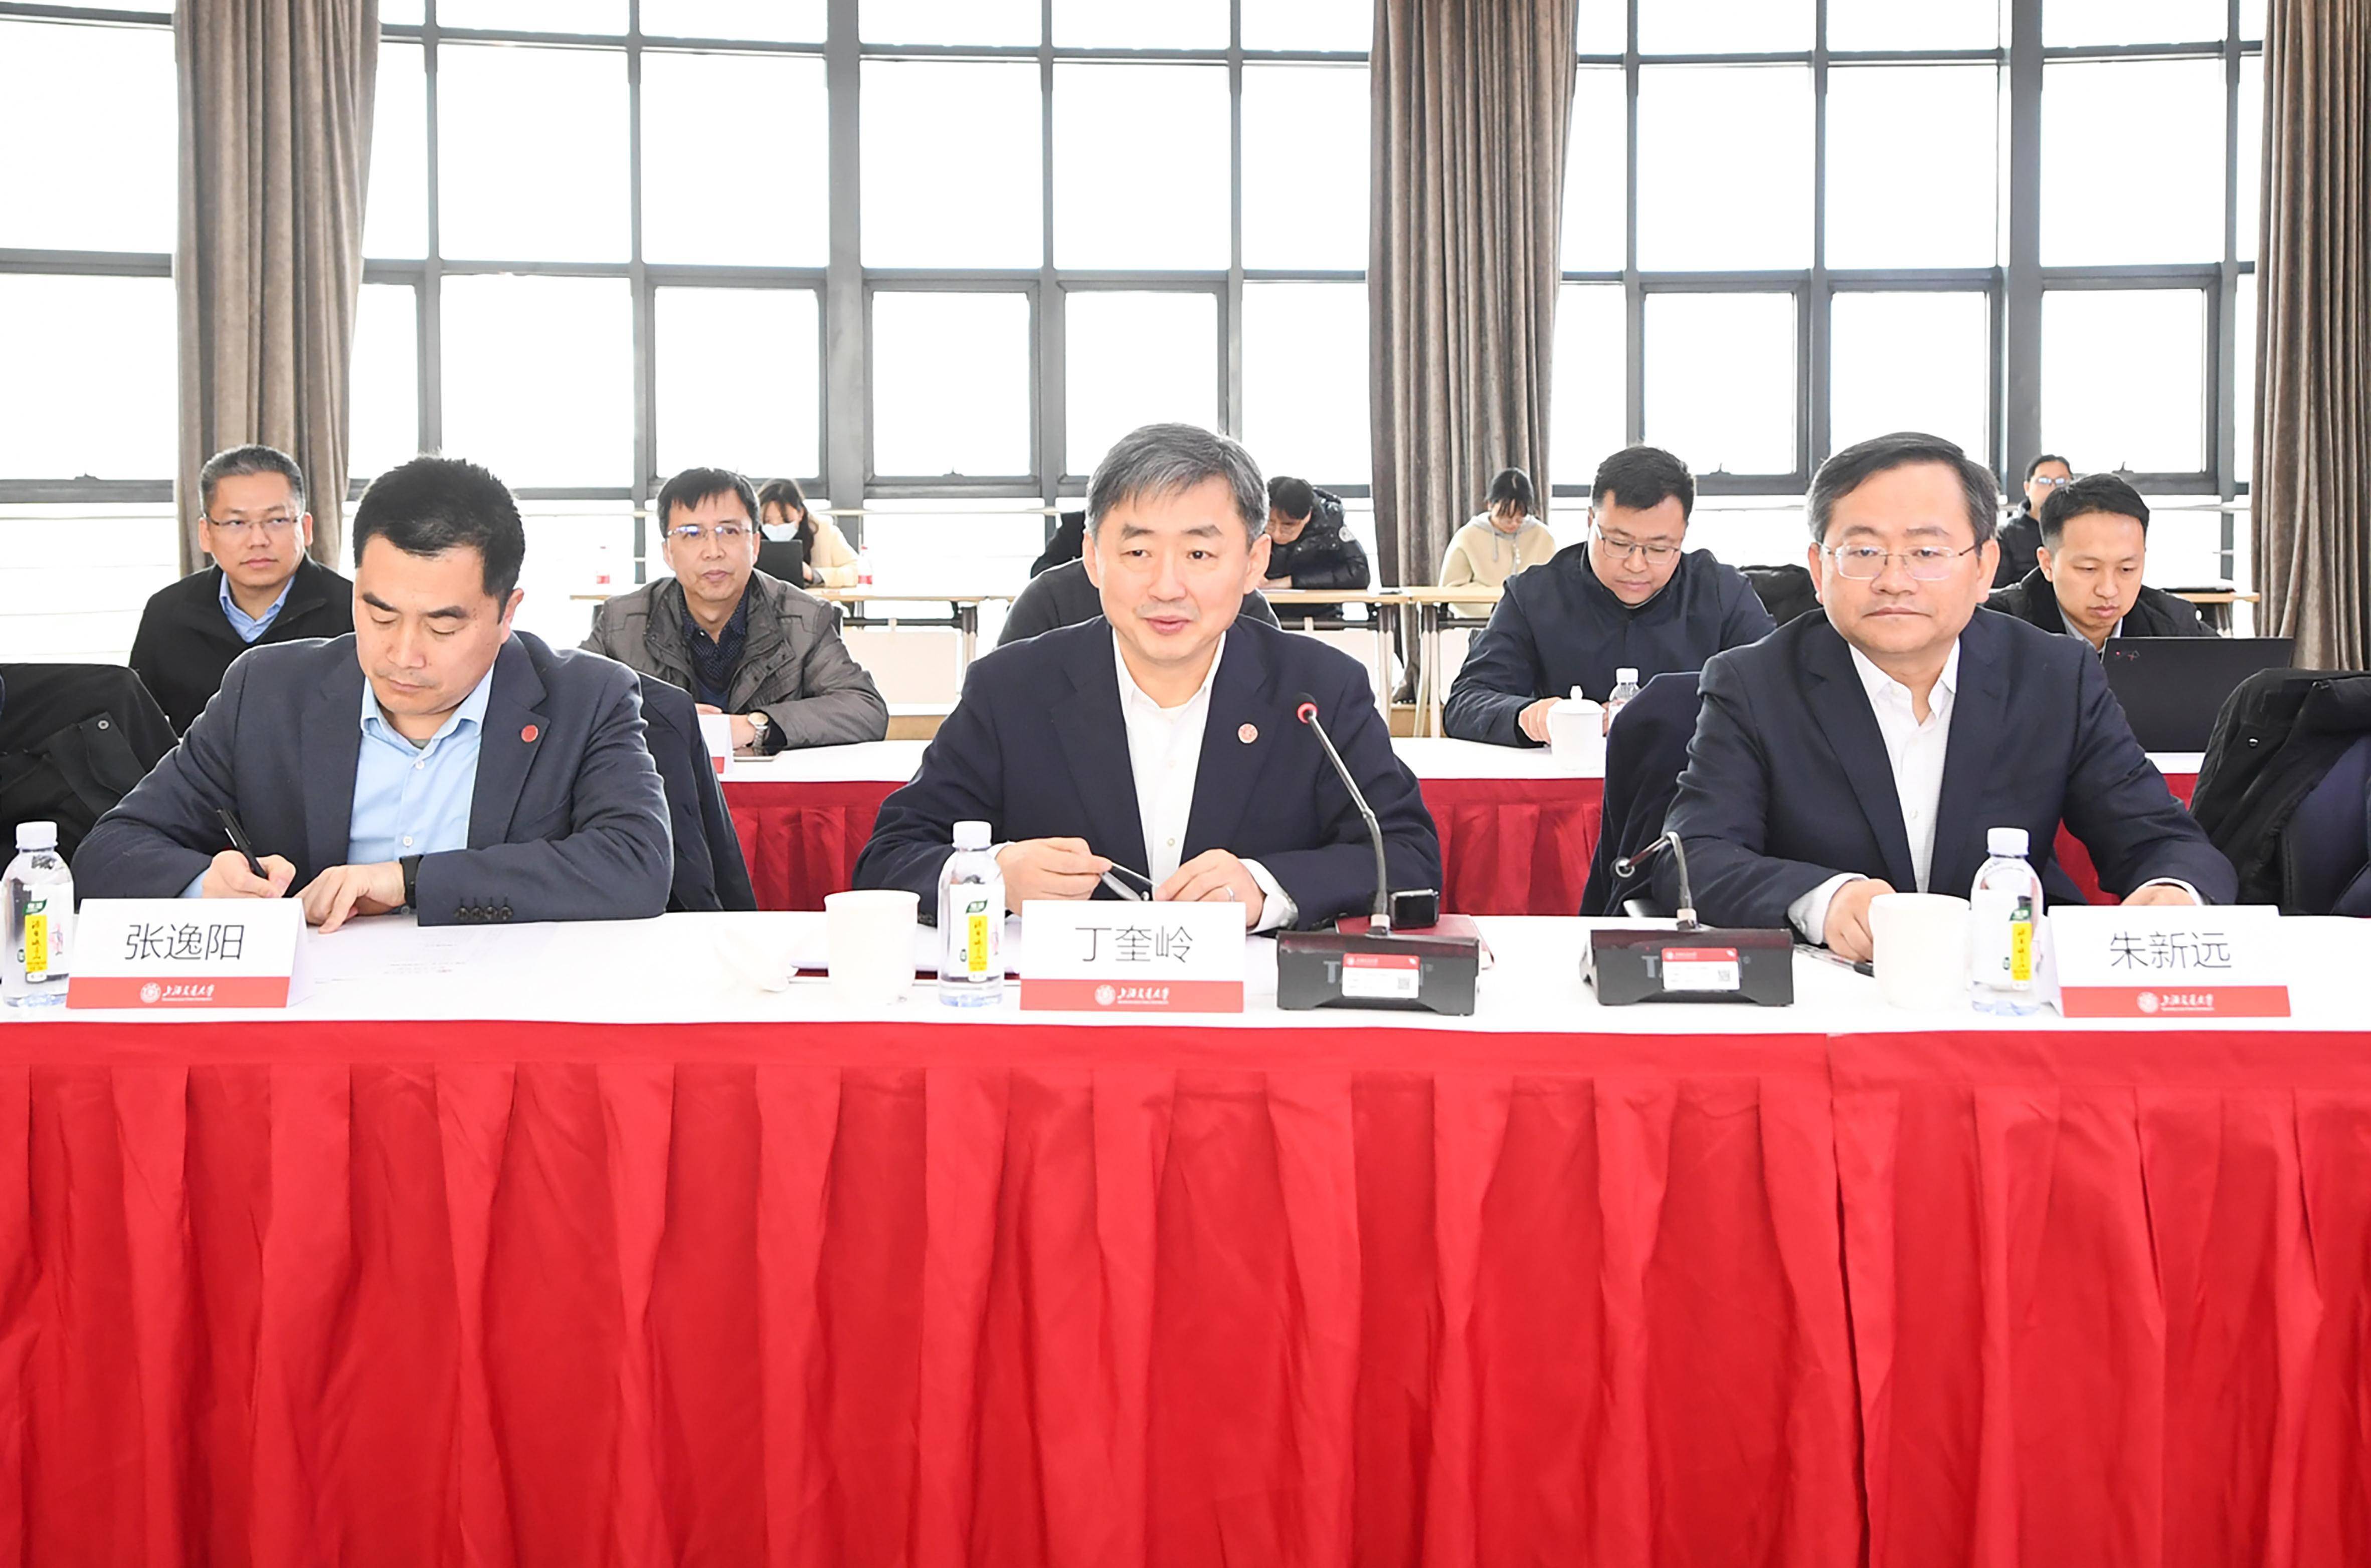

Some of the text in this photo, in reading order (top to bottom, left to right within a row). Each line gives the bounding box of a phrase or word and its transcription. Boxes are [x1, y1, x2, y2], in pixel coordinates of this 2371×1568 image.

[125, 923, 245, 960] 张逸阳
[1075, 925, 1193, 962] 丁奎岭
[2110, 931, 2232, 969] 朱新远
